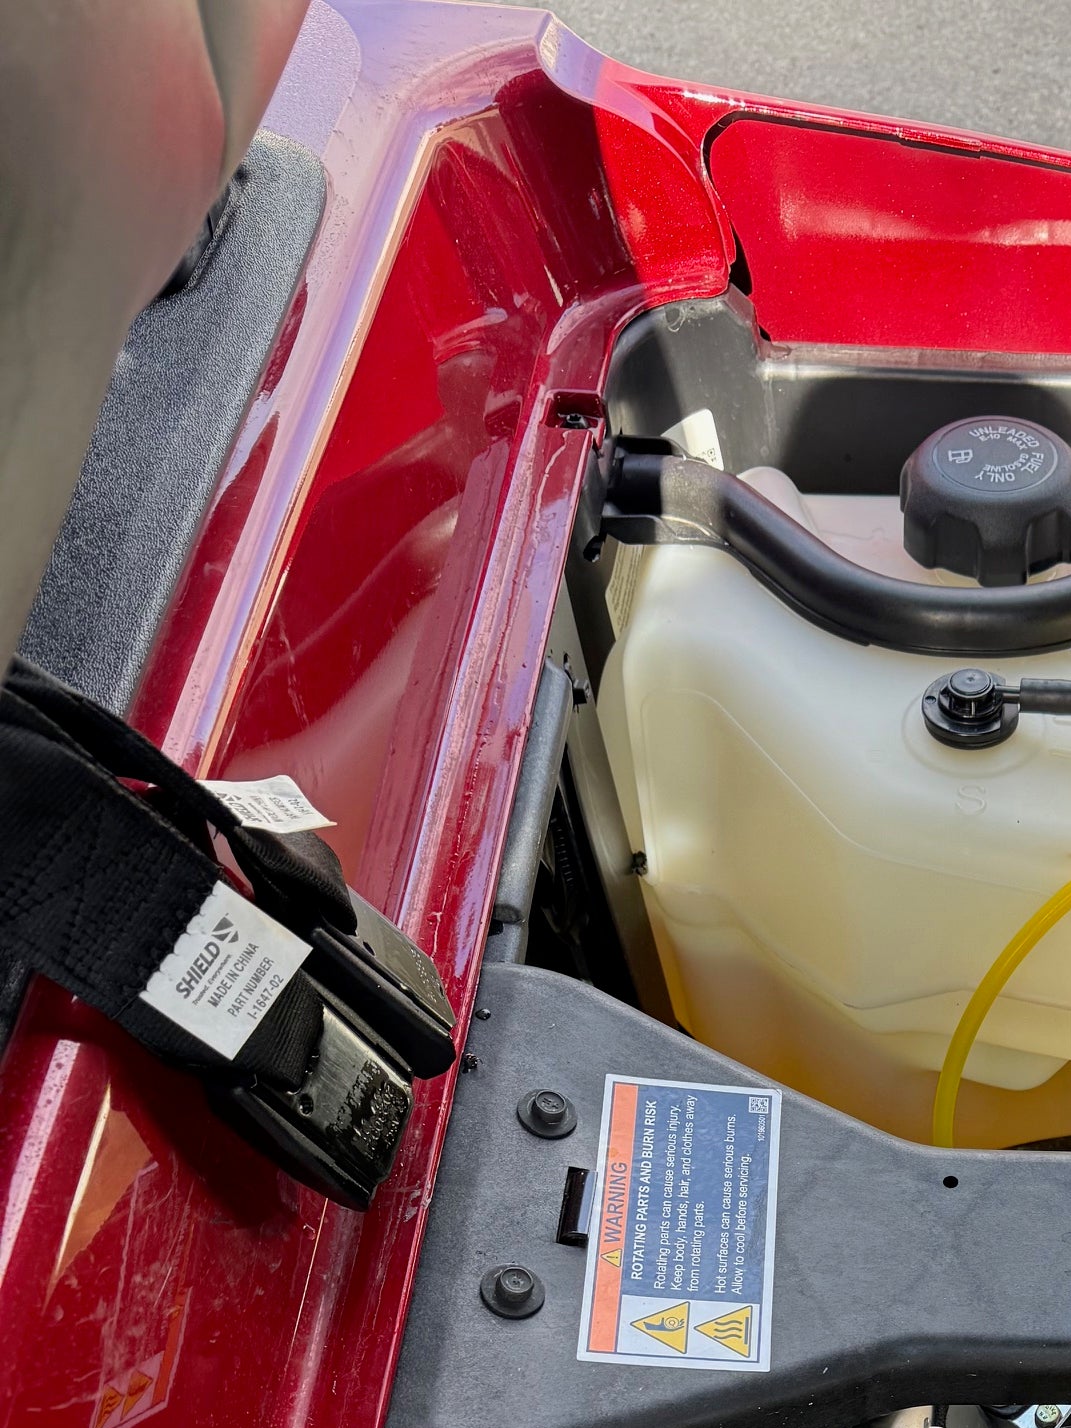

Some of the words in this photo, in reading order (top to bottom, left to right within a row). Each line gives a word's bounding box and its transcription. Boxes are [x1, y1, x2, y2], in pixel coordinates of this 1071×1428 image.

[969, 426, 1040, 447] UNLEADED
[979, 434, 1000, 442] E-10
[1007, 436, 1028, 450] MAX
[974, 470, 1015, 482] ONLY
[983, 453, 1029, 472] GASOLINE
[1021, 452, 1044, 474] FUEL
[175, 941, 220, 999] SHIELD
[207, 978, 233, 1008] MADE
[224, 969, 240, 983] IN
[232, 942, 259, 972] CHINA
[226, 991, 249, 1017] PART
[242, 956, 274, 996] NUMBER
[644, 1100, 657, 1126] RISK
[666, 1104, 681, 1132] injury.
[685, 1094, 698, 1120] away
[681, 1121, 694, 1155] clothes
[723, 1114, 736, 1142] burns.
[641, 1128, 655, 1158] BURN
[664, 1133, 677, 1168] serious
[639, 1160, 652, 1184] AND
[679, 1157, 693, 1176] and
[722, 1144, 734, 1179] serious
[737, 1153, 752, 1198] servicing.
[663, 1169, 674, 1198] cause
[676, 1178, 691, 1198] hair,
[722, 1180, 732, 1210] cause
[603, 1162, 628, 1243] WARNING
[635, 1185, 650, 1221] PARTS
[662, 1200, 672, 1218] can
[674, 1200, 690, 1233] hands,
[693, 1200, 706, 1228] parts.
[734, 1199, 747, 1231] before
[659, 1220, 671, 1245] parts
[720, 1211, 731, 1229] can
[630, 1223, 647, 1280] ROTATING
[672, 1235, 688, 1262] body,
[689, 1229, 705, 1266] rotating
[716, 1231, 729, 1273] surfaces
[734, 1232, 745, 1254] cool
[653, 1247, 671, 1289] Rotating
[732, 1255, 744, 1265] to
[670, 1264, 686, 1290] Keep
[686, 1269, 700, 1292] from
[714, 1275, 727, 1293] Hot
[730, 1267, 746, 1295] Allow
